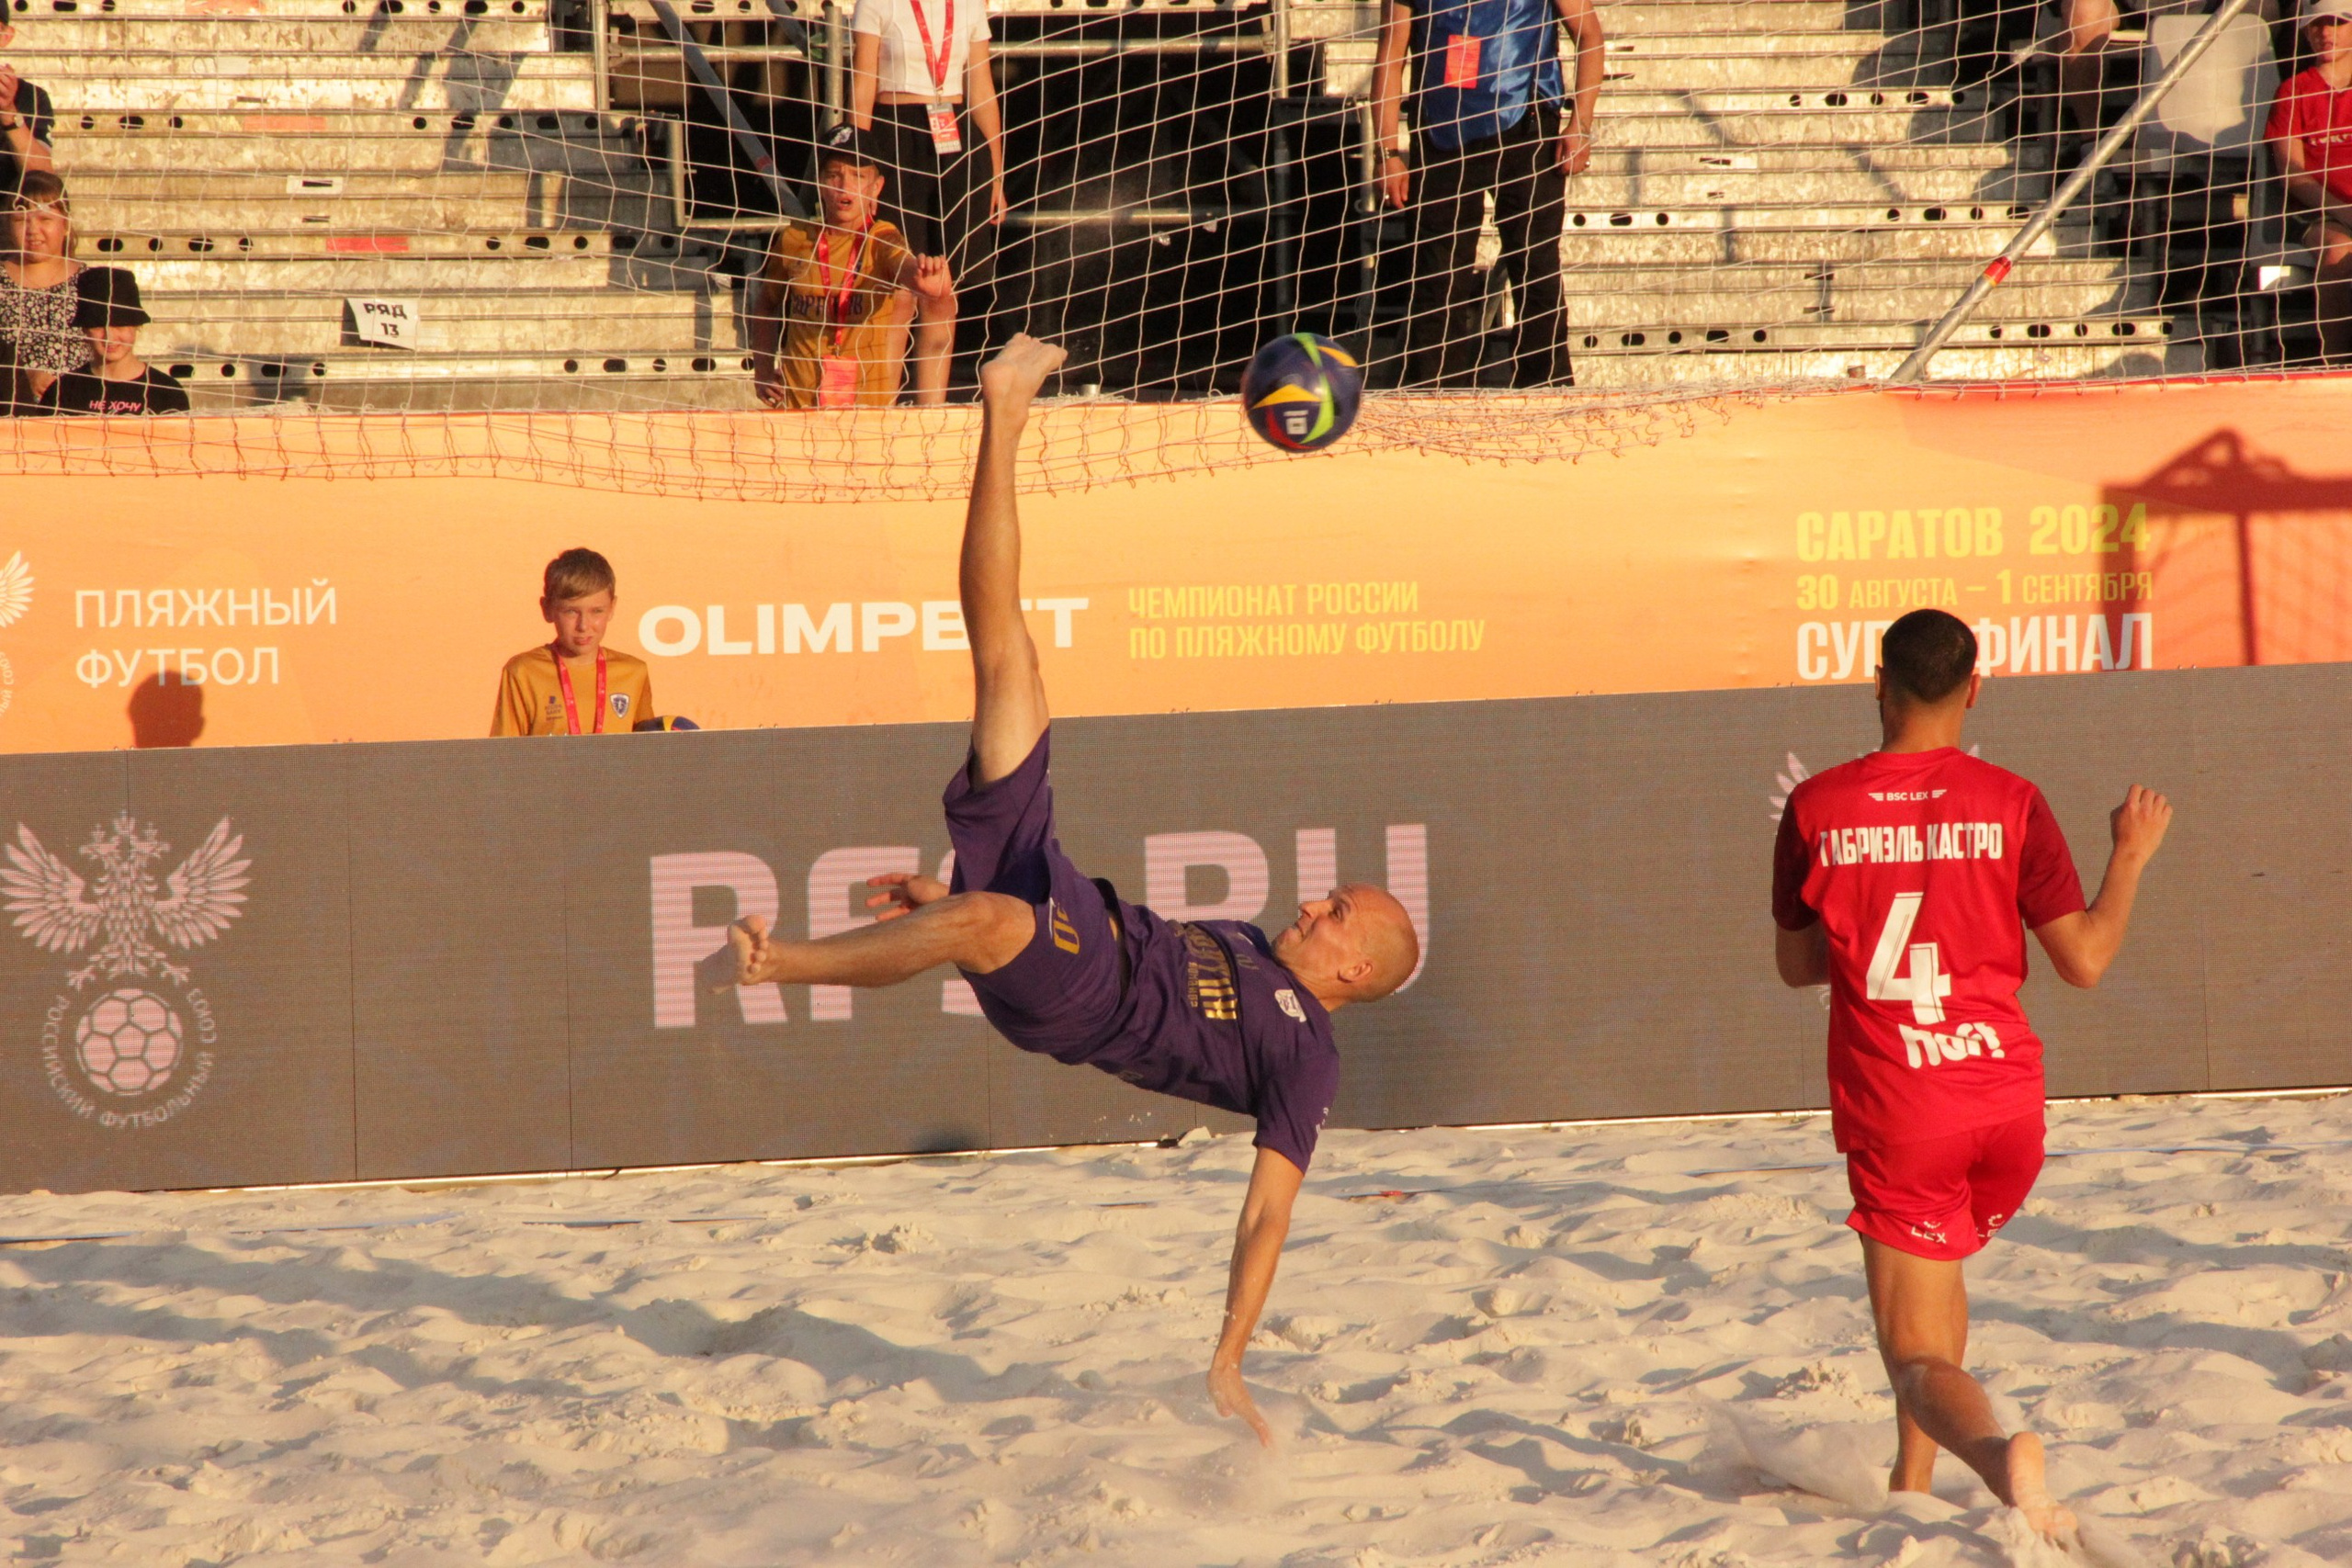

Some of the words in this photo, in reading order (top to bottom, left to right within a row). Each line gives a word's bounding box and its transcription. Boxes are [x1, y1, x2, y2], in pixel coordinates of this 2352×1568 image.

[362, 303, 408, 320] РЯД
[380, 322, 400, 338] 13
[89, 400, 107, 410] НЕ
[108, 400, 141, 412] ХОЧУ
[1796, 506, 2004, 562] САРАТОВ
[2029, 502, 2152, 555] 2024
[75, 578, 337, 627] ПЛЯЖНЫЙ
[1128, 583, 1297, 619] ЧЕМПИОНАТ
[1306, 581, 1419, 615] РОССИИ
[1796, 573, 1838, 610] 30
[1849, 577, 1958, 609] АВГУСТА
[1996, 569, 2012, 604] 1
[2022, 571, 2153, 604] СЕНТЯБРЯ
[638, 597, 1091, 657] OLIMPBT
[1129, 626, 1167, 659] ПО
[1175, 623, 1347, 658] ПЛЯЖНОМУ
[1355, 619, 1486, 654] ФУТБОЛУ
[1796, 613, 2153, 680] СУПФИНАЛ
[75, 647, 279, 688] ФУТБОЛ
[1886, 792, 1908, 801] BSC
[1909, 791, 1928, 801] LEX
[1819, 825, 1924, 867] ГАБРИЭЛЬ
[1927, 822, 2004, 860] КАСТРО
[1866, 891, 1951, 1025] 4
